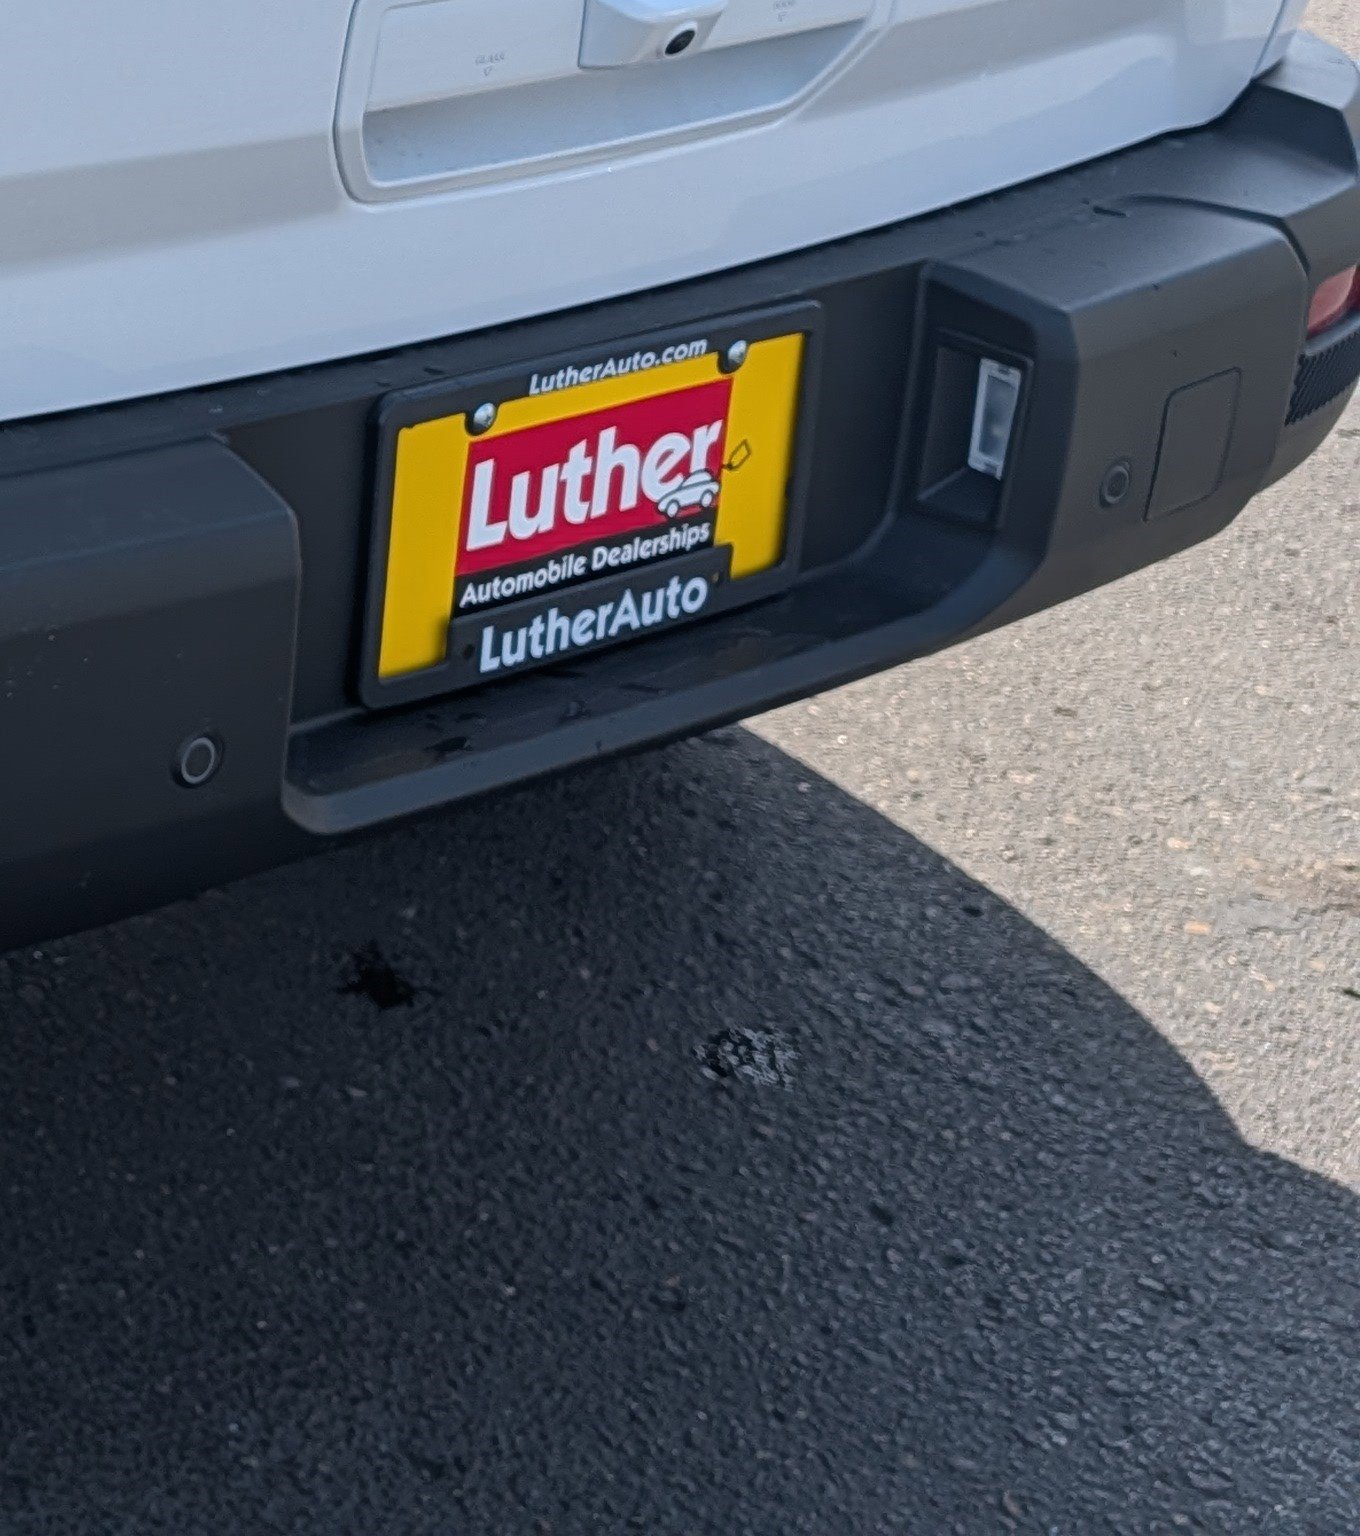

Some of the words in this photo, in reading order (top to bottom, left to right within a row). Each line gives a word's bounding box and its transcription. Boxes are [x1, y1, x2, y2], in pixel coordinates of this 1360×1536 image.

[528, 338, 709, 396] LutherAuto.com
[465, 418, 723, 552] Luther
[459, 553, 587, 609] Automobile
[591, 521, 711, 571] Dealerships
[480, 576, 709, 673] LutherAuto
